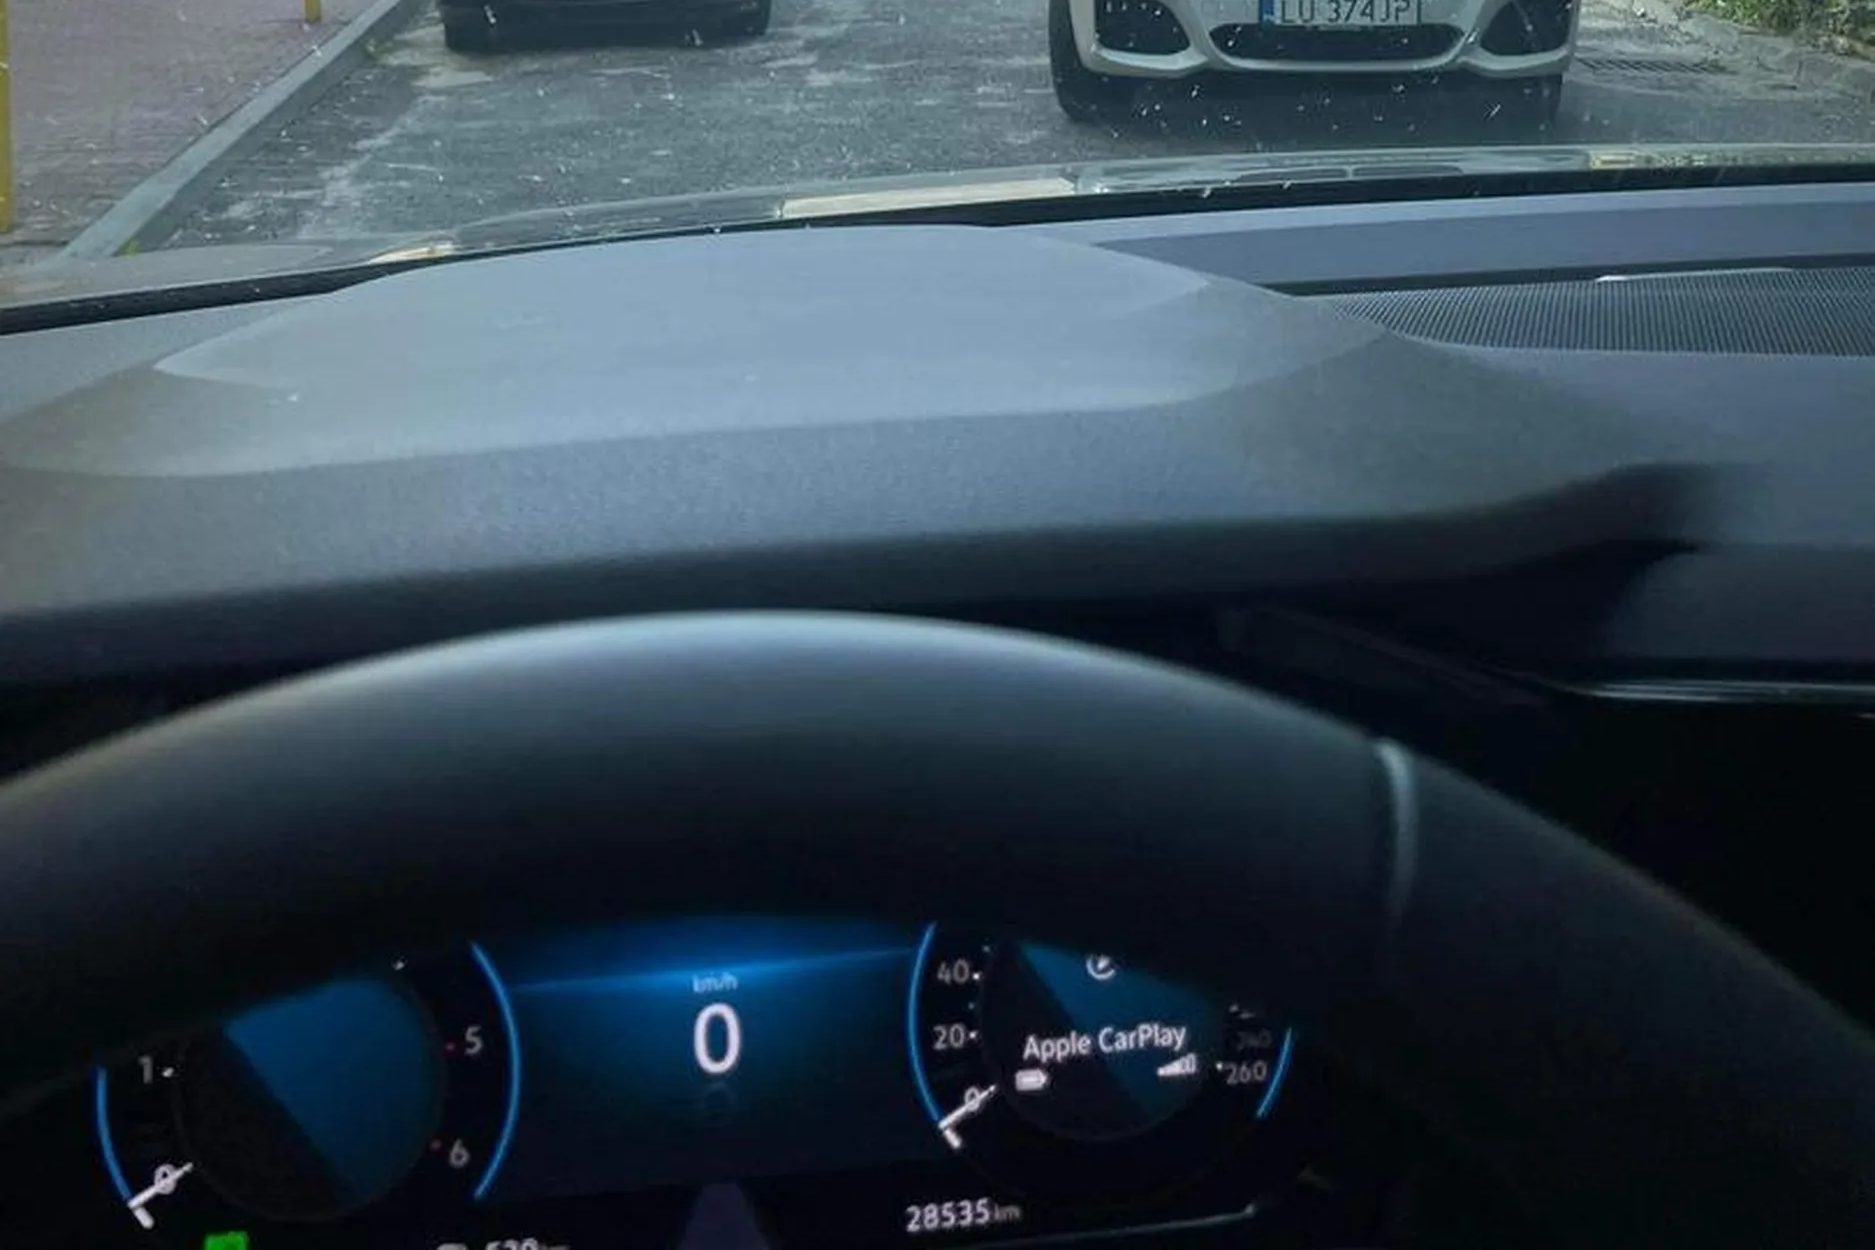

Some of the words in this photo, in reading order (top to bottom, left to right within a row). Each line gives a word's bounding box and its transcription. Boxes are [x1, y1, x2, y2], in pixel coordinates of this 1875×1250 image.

[1281, 0, 1315, 24] LU
[937, 958, 970, 986] 40
[464, 1025, 484, 1057] 5
[694, 1002, 741, 1074] 0
[933, 1023, 966, 1051] 20
[1022, 1028, 1092, 1064] Apple
[1099, 1021, 1187, 1055] CarPlay
[138, 1054, 153, 1085] 1
[1223, 1060, 1269, 1086] 260
[449, 1138, 471, 1169] 6
[906, 1197, 990, 1232] 28535
